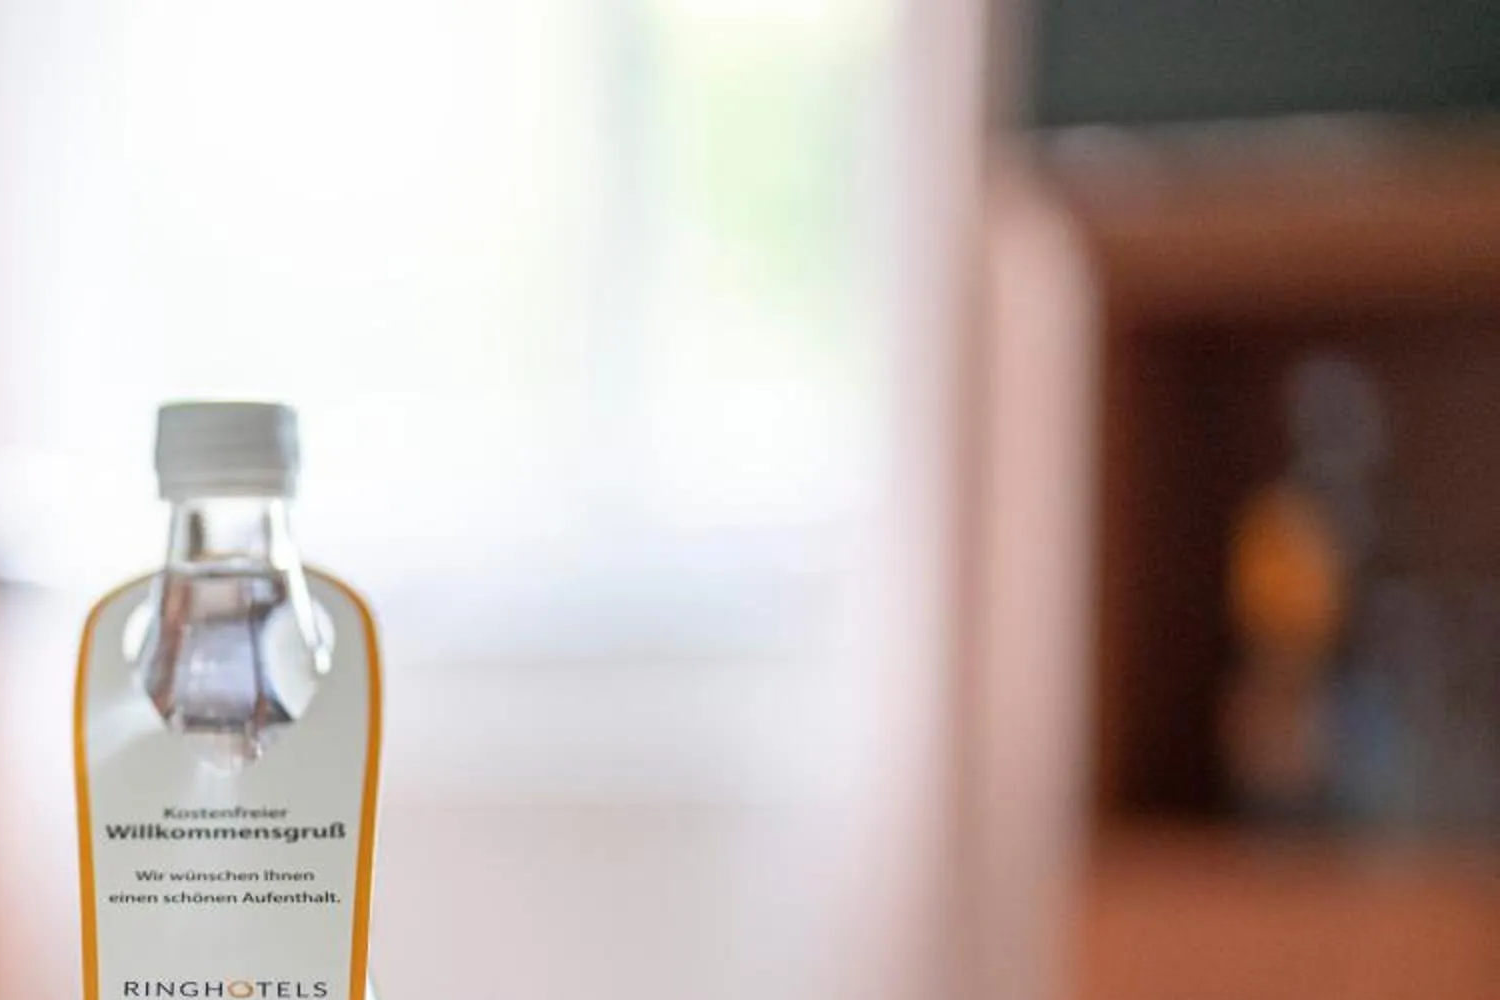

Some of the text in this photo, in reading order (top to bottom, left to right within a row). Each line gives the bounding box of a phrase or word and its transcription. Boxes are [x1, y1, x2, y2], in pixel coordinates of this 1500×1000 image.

[163, 806, 288, 819] Kostenfreier
[105, 821, 346, 843] Willkommensgruß
[135, 869, 315, 881] Wir wünschen Ihnen
[108, 890, 341, 903] einen schönen Aufenthalt.
[123, 980, 329, 999] RINGHOTELS
